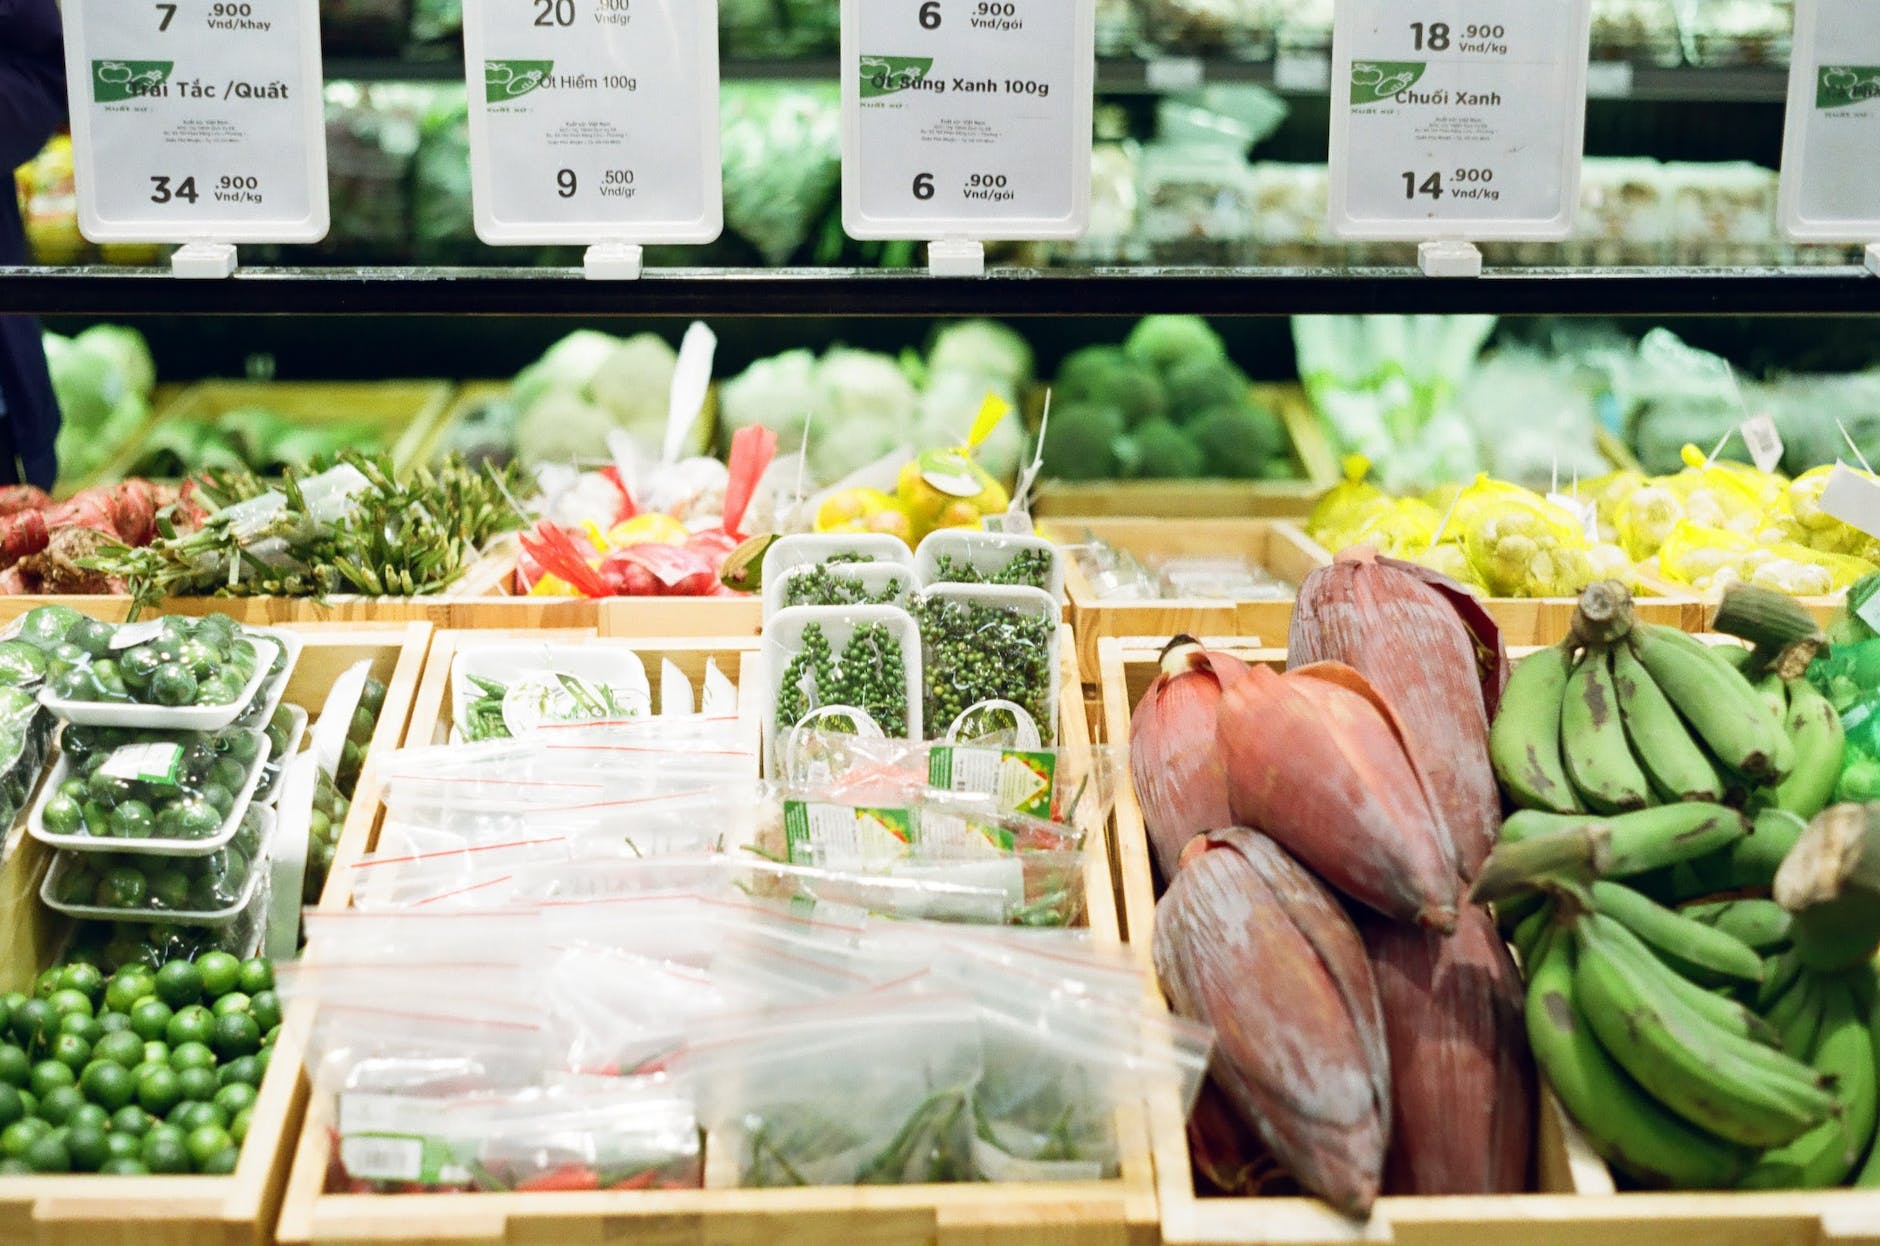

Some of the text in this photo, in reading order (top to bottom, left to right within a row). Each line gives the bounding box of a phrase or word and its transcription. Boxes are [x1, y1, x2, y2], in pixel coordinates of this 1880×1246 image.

[156, 3, 251, 32] 7 .900
[534, 0, 575, 27] 20
[919, 1, 1015, 30] 6 .900
[208, 19, 271, 31] Vnd/khay
[971, 18, 1023, 30] Vnd/gói
[1410, 22, 1504, 51] 18 .900
[1459, 42, 1507, 55] Vnd/kg
[177, 79, 216, 98] Tắc
[604, 75, 636, 91] 100g
[952, 78, 997, 93] Xanh
[1004, 80, 1049, 97] 100g
[1456, 91, 1501, 105] Xanh
[151, 176, 258, 204] 34 .900
[557, 169, 634, 198] 9 .500
[600, 187, 636, 198] Vnd/gr
[913, 173, 1007, 200] 6 .900
[1402, 169, 1493, 199] 14 .900
[215, 192, 262, 204] Vnd/kg
[964, 189, 1014, 201] Vnd/gói
[1452, 188, 1500, 200] Vnd/kg
